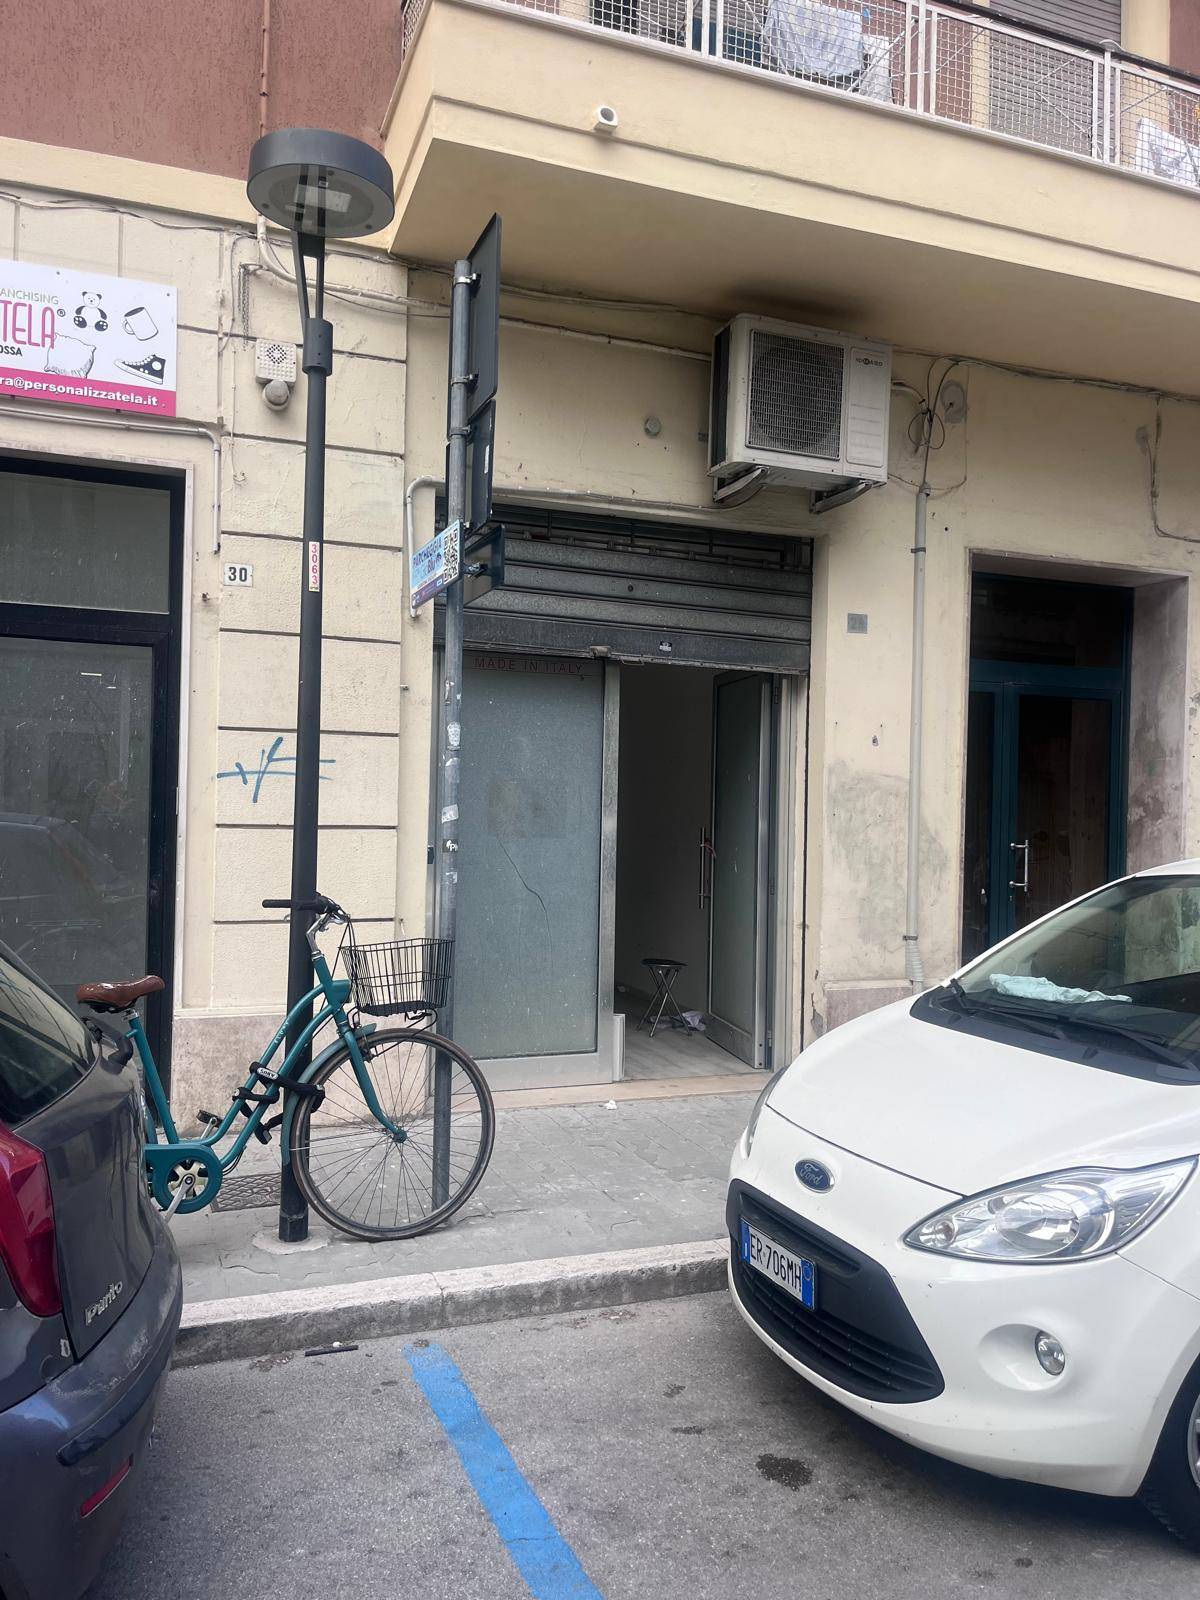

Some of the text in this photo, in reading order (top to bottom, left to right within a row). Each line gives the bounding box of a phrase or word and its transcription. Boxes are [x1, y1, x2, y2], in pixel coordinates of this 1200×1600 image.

[228, 566, 248, 582] 30
[473, 657, 583, 674] MADE IN ITALY
[799, 1162, 826, 1187] Ford
[85, 1281, 123, 1326] Punto
